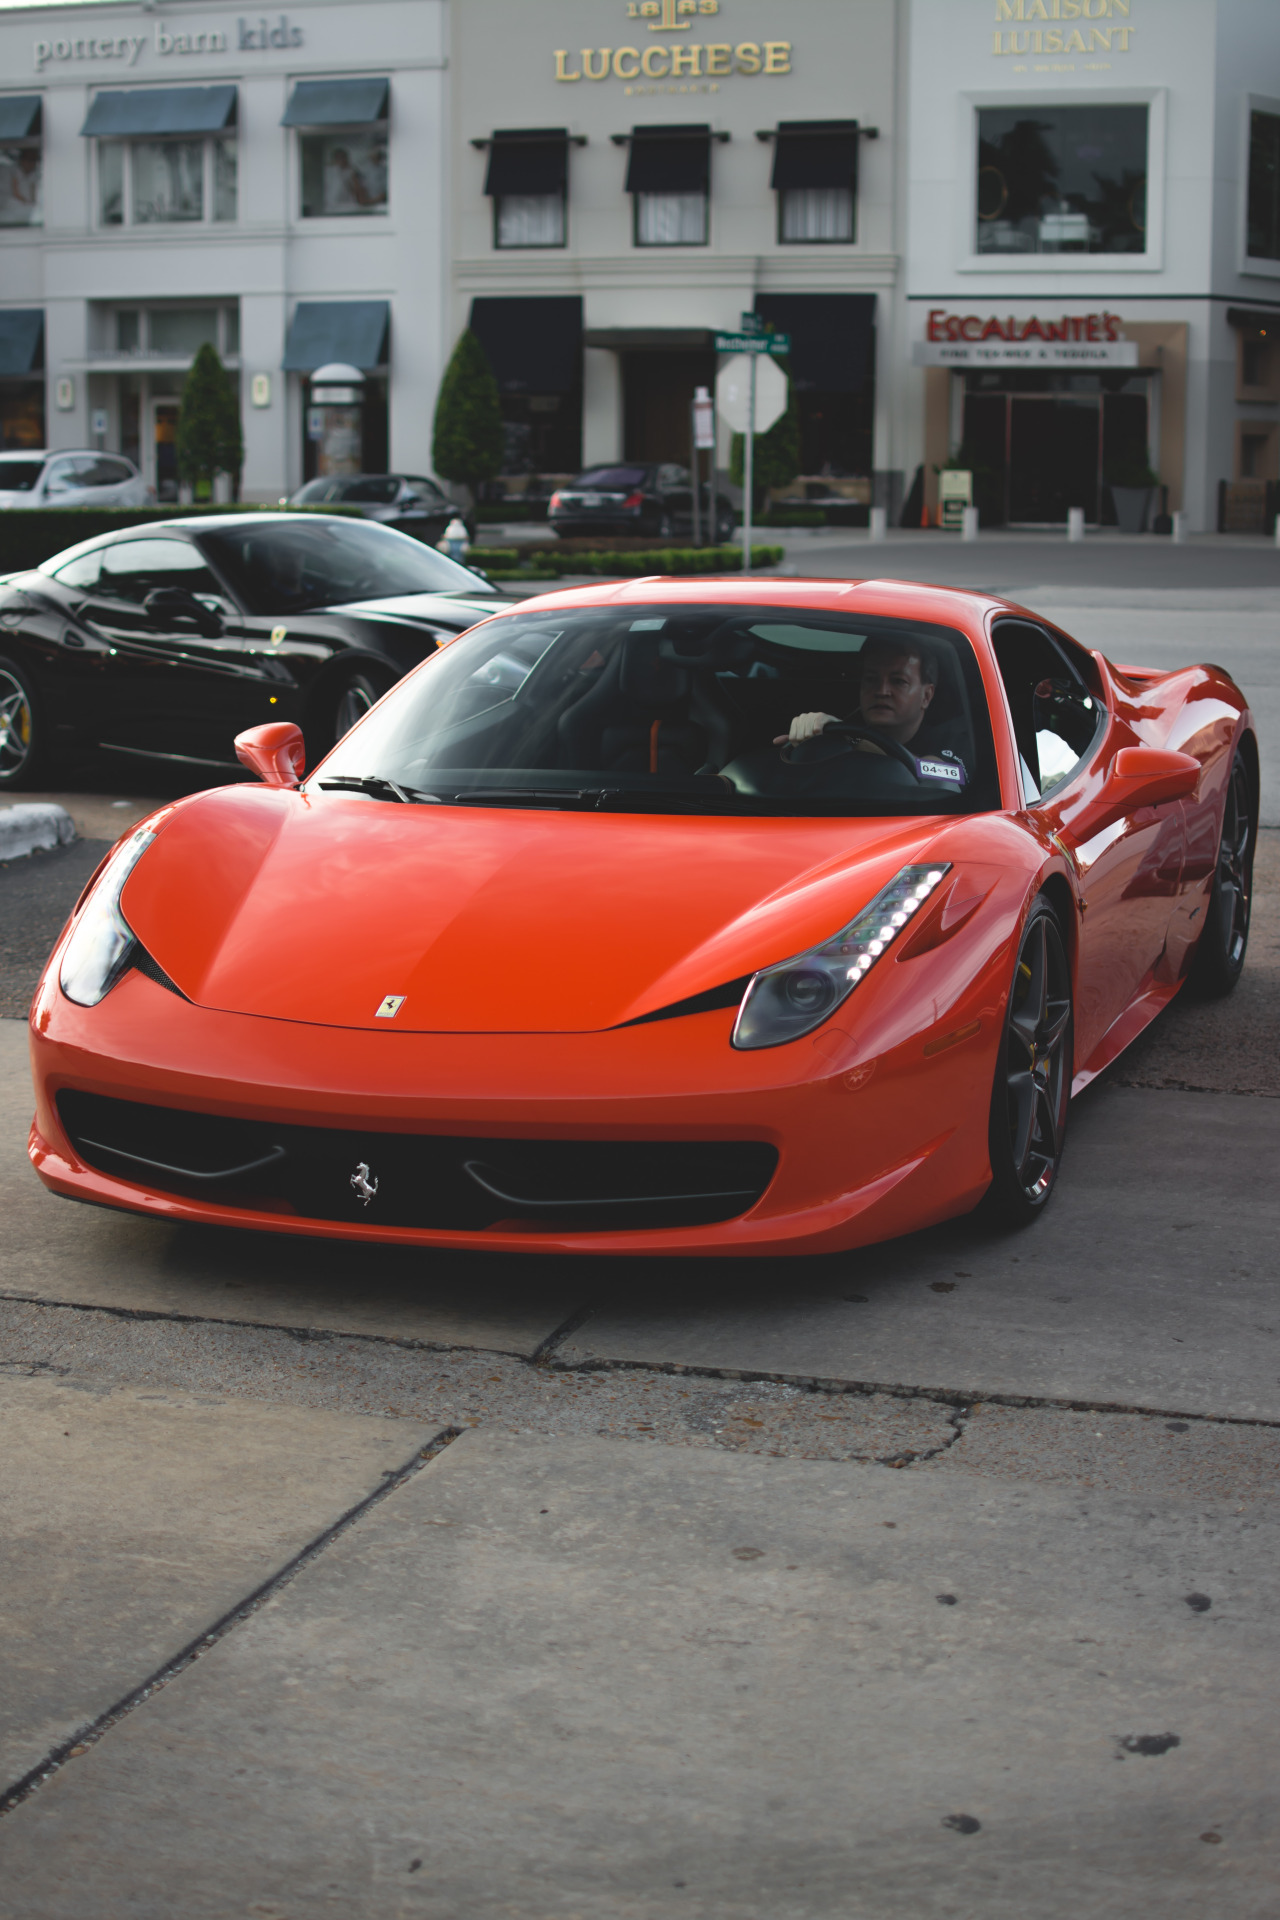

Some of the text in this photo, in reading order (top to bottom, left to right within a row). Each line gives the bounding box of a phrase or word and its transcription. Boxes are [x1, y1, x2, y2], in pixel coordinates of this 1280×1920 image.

[995, 0, 1130, 21] MAISON
[33, 15, 305, 73] pottery barn kids
[992, 27, 1135, 56] LUISANT
[553, 41, 792, 82] LUCCHESE
[927, 309, 1123, 342] ESCALANTE'S
